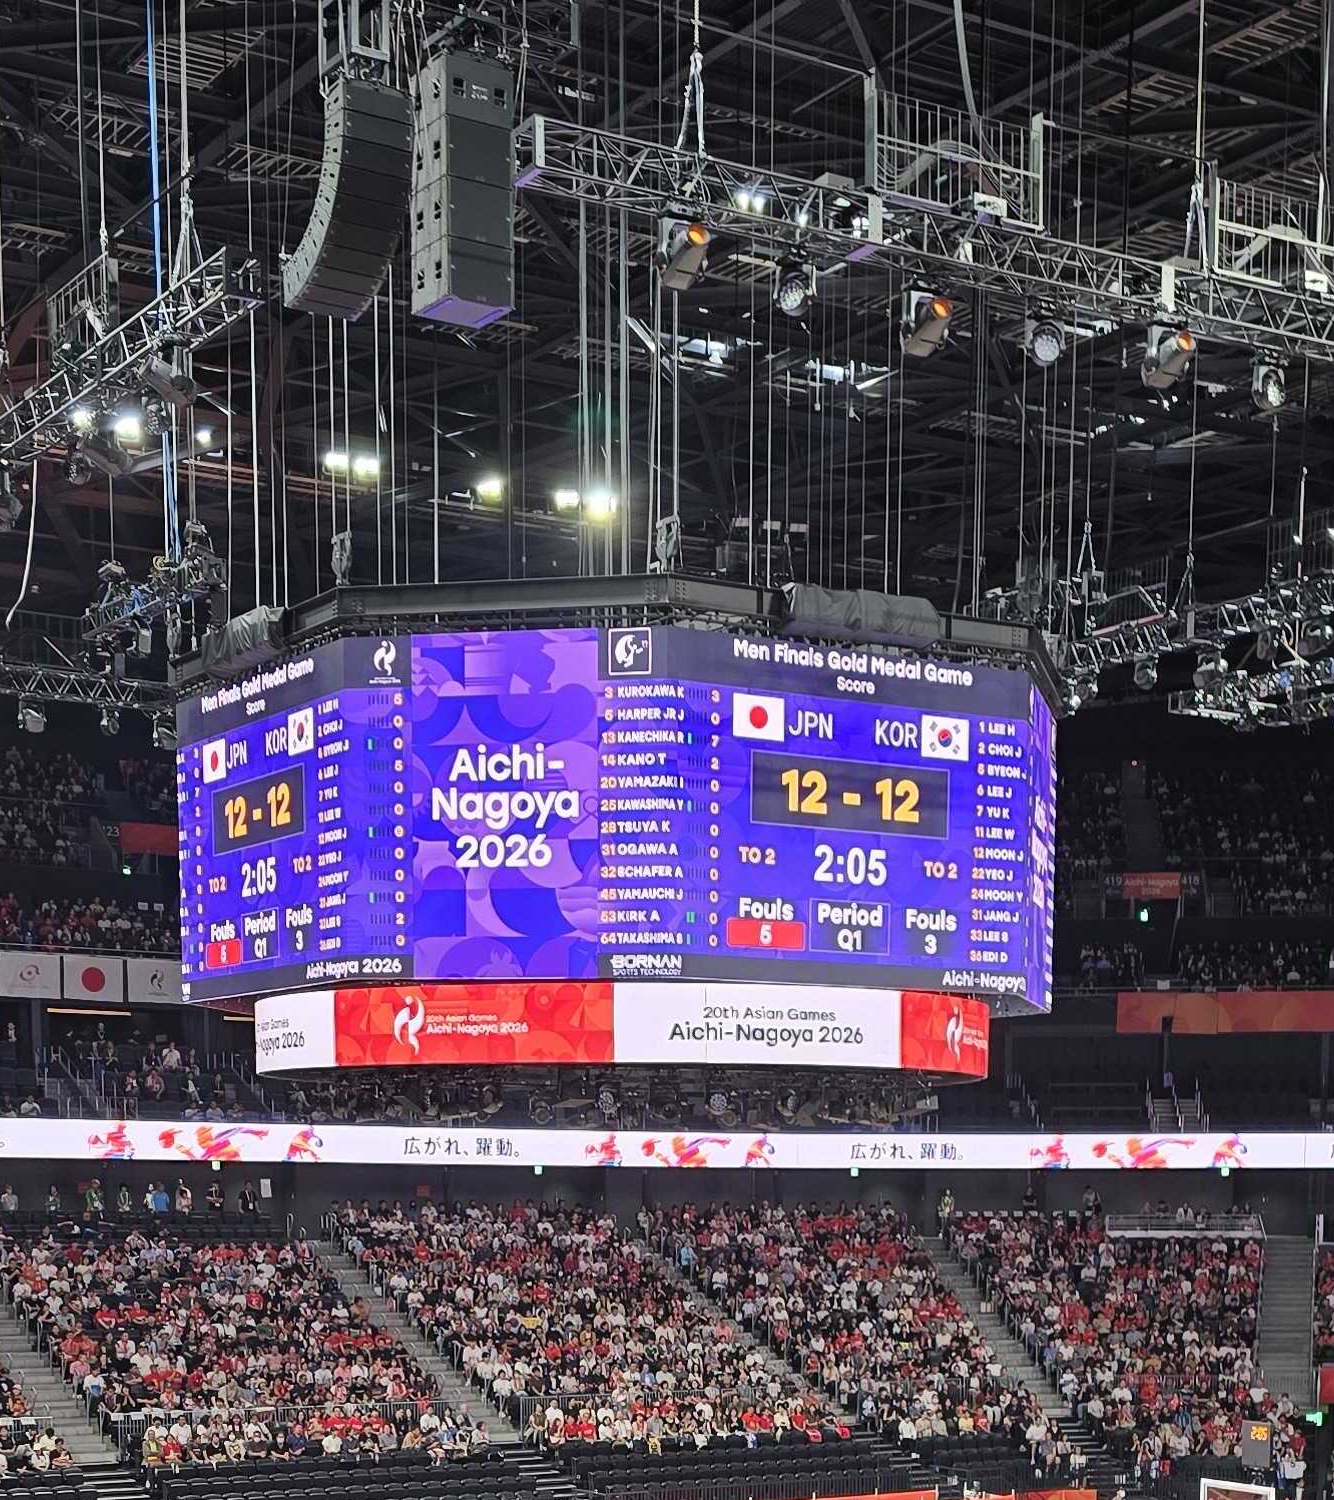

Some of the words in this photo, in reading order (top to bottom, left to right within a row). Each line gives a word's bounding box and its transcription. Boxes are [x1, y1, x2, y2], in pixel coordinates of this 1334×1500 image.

[733, 638, 770, 662] Men
[774, 642, 824, 668] Finals
[827, 651, 867, 674] Gold
[870, 656, 921, 681] Medal
[924, 663, 974, 687] Game
[617, 685, 676, 698] KUROKAWA
[836, 675, 875, 695] Score
[617, 707, 661, 720] HARPER
[788, 710, 833, 740] JPN
[875, 718, 918, 749] KOR
[226, 741, 247, 769] JPN
[265, 731, 287, 757] KOR
[617, 753, 656, 766] KANO
[449, 743, 565, 782] Aichi-
[781, 768, 828, 816] 12
[875, 777, 920, 824] 12
[224, 796, 247, 840] 12
[267, 782, 291, 828] 12
[431, 787, 580, 831] Nagoya
[616, 820, 658, 833] TSUYA
[454, 833, 552, 869] 2026
[616, 843, 667, 856] OGAWA
[738, 846, 761, 863] TO
[764, 847, 776, 865] 2
[813, 843, 888, 887] 2:05
[923, 860, 945, 878] TO
[947, 862, 958, 880] 2
[241, 857, 276, 898] 2:05
[211, 920, 236, 944] Fouls
[244, 911, 276, 937] Period
[285, 904, 312, 928] Fouls
[616, 910, 647, 922] KIRK
[739, 896, 794, 921] Fouls
[817, 902, 883, 928] Period
[905, 908, 957, 932] Fouls
[759, 925, 773, 945] 5
[837, 929, 862, 953] Q1
[924, 934, 938, 955] 3
[361, 957, 403, 974] 2026
[610, 954, 683, 969] BORNAN
[702, 1005, 738, 1020] 20th
[743, 1006, 784, 1020] Asian
[787, 1007, 836, 1022] Games
[426, 1022, 499, 1036] Aichi-Nagoya
[500, 1022, 528, 1034] 2026
[668, 1021, 813, 1048] Aichi-Nagoya
[818, 1026, 864, 1044] 2026
[404, 1136, 522, 1156] 広がれ、躍動。
[850, 1142, 965, 1161] 広がれ、躍動。
